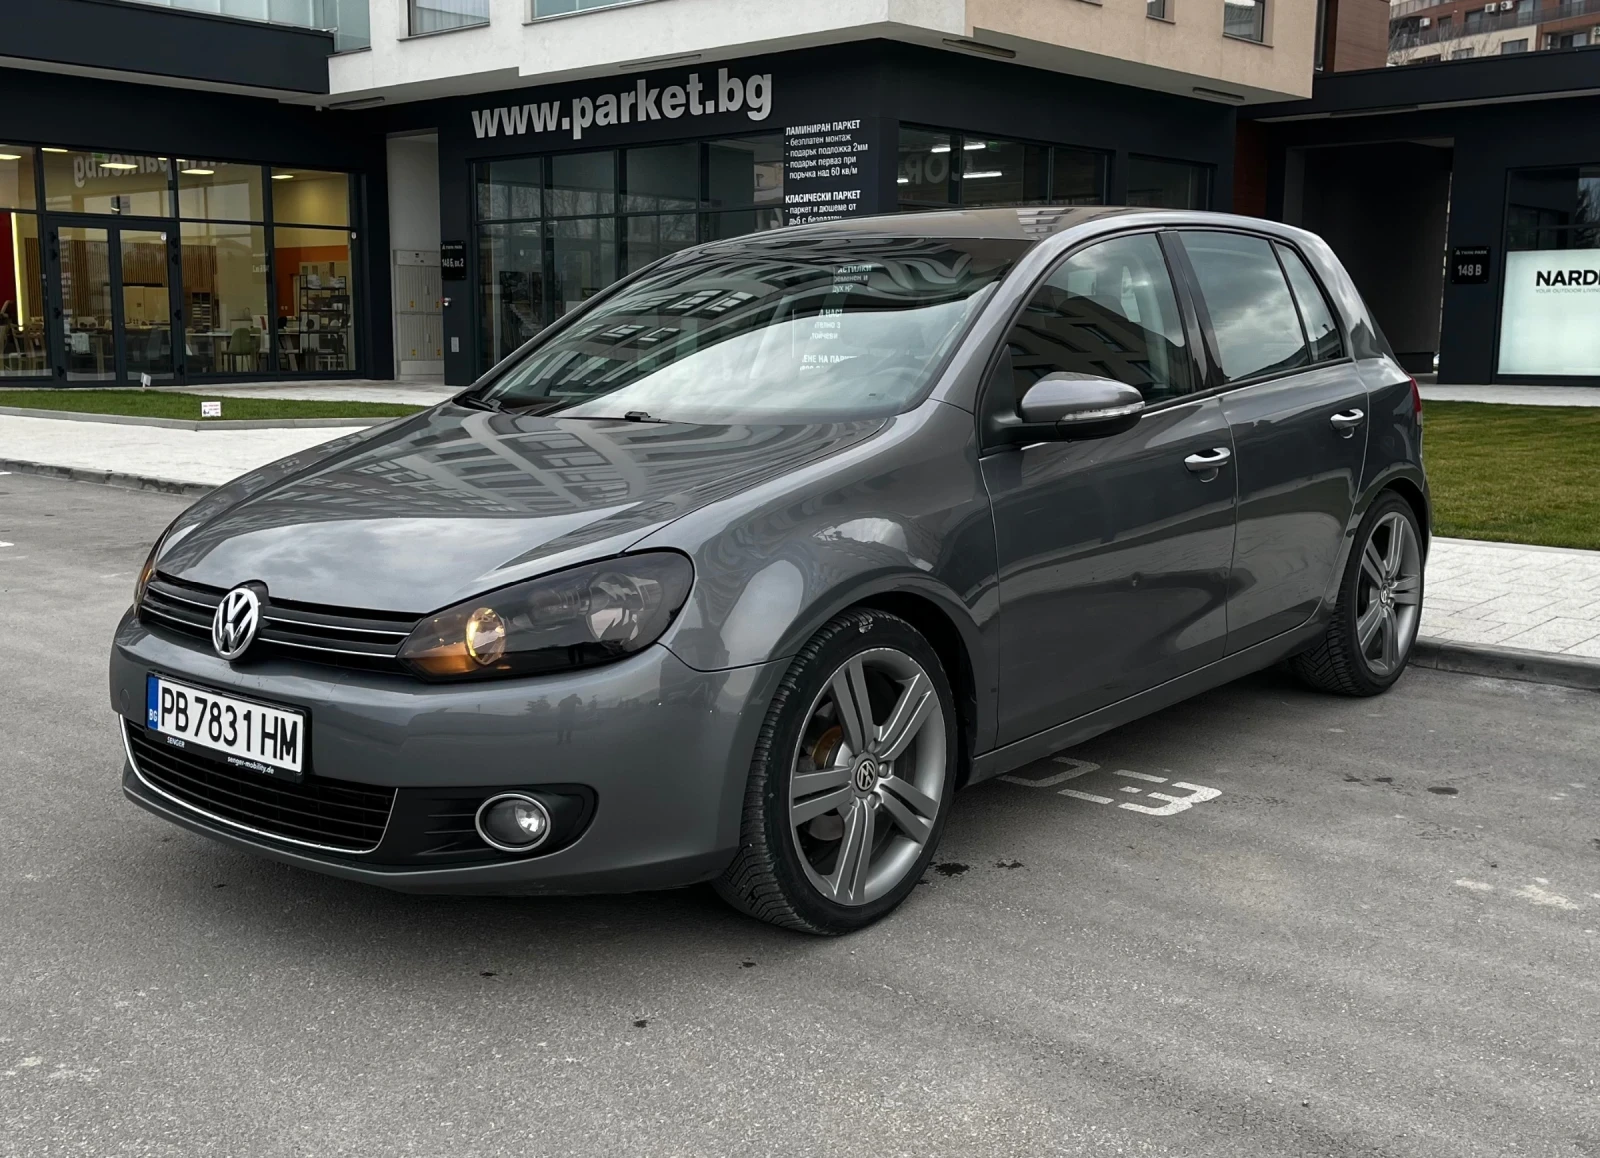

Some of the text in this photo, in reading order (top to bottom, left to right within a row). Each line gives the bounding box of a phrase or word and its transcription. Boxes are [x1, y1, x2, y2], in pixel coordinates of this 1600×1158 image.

[471, 68, 772, 139] www.parket.bg
[785, 120, 860, 136] ЛАМИНИРАН ПАРКЕТ
[790, 137, 824, 147] безплатен
[825, 133, 851, 142] монтаж
[818, 145, 851, 155] подложка
[853, 143, 868, 152] 2мм
[818, 157, 842, 166] перваз
[843, 155, 856, 165] при
[817, 169, 830, 177] над
[831, 167, 840, 176] 60
[841, 166, 857, 176] кв/м
[785, 190, 861, 204] КЛАСИЧЕСКИ ПАРКЕТ
[790, 205, 811, 215] паркет
[819, 204, 847, 213] дюшеме
[1457, 264, 1473, 276] 148
[149, 709, 158, 722] BG
[167, 736, 185, 748] SENGER
[227, 756, 275, 774] senger-mobility.de
